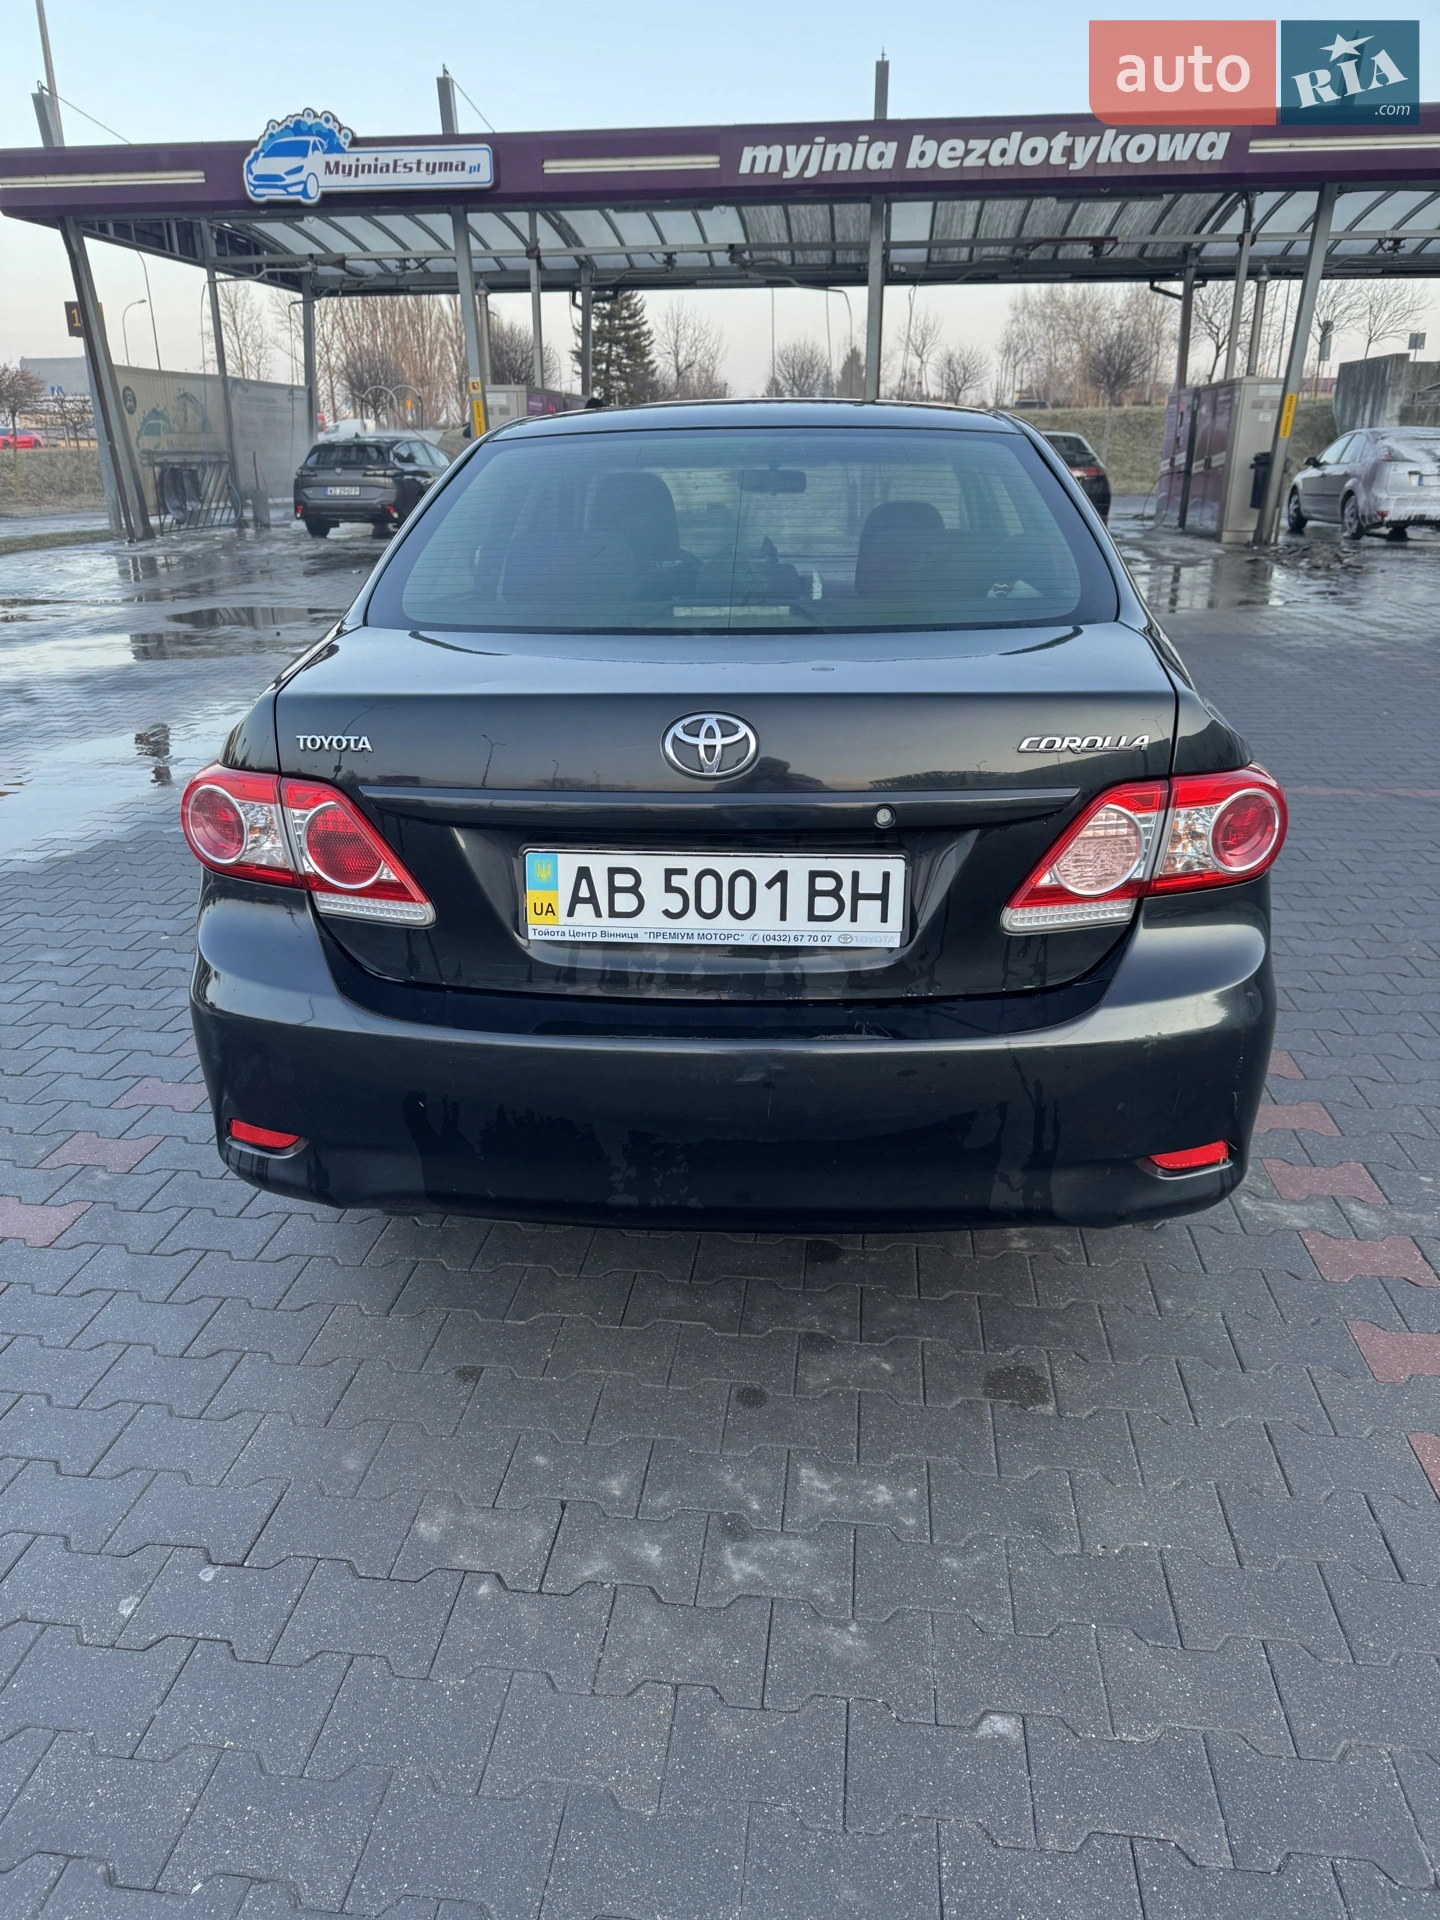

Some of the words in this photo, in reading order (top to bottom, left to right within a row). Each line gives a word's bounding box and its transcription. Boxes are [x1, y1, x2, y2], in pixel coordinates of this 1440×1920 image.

[737, 136, 897, 179] myjnia
[906, 129, 1231, 171] bezdotykowa
[71, 308, 81, 327] 1
[296, 734, 373, 753] TOYOTA
[1017, 734, 1151, 754] COROLLA
[567, 866, 645, 919] AB
[661, 868, 788, 921] 5001
[807, 870, 891, 923] BH
[533, 902, 556, 917] UA
[532, 928, 566, 938] Тойота
[568, 930, 598, 940] Центр
[600, 930, 639, 940] Вінниця
[644, 931, 695, 941] "ПРЕМІУМ
[697, 932, 745, 942] МОТОРС"
[762, 933, 791, 943] (0432)
[793, 934, 803, 943] 67
[807, 934, 818, 943] 70
[821, 935, 832, 943] 07
